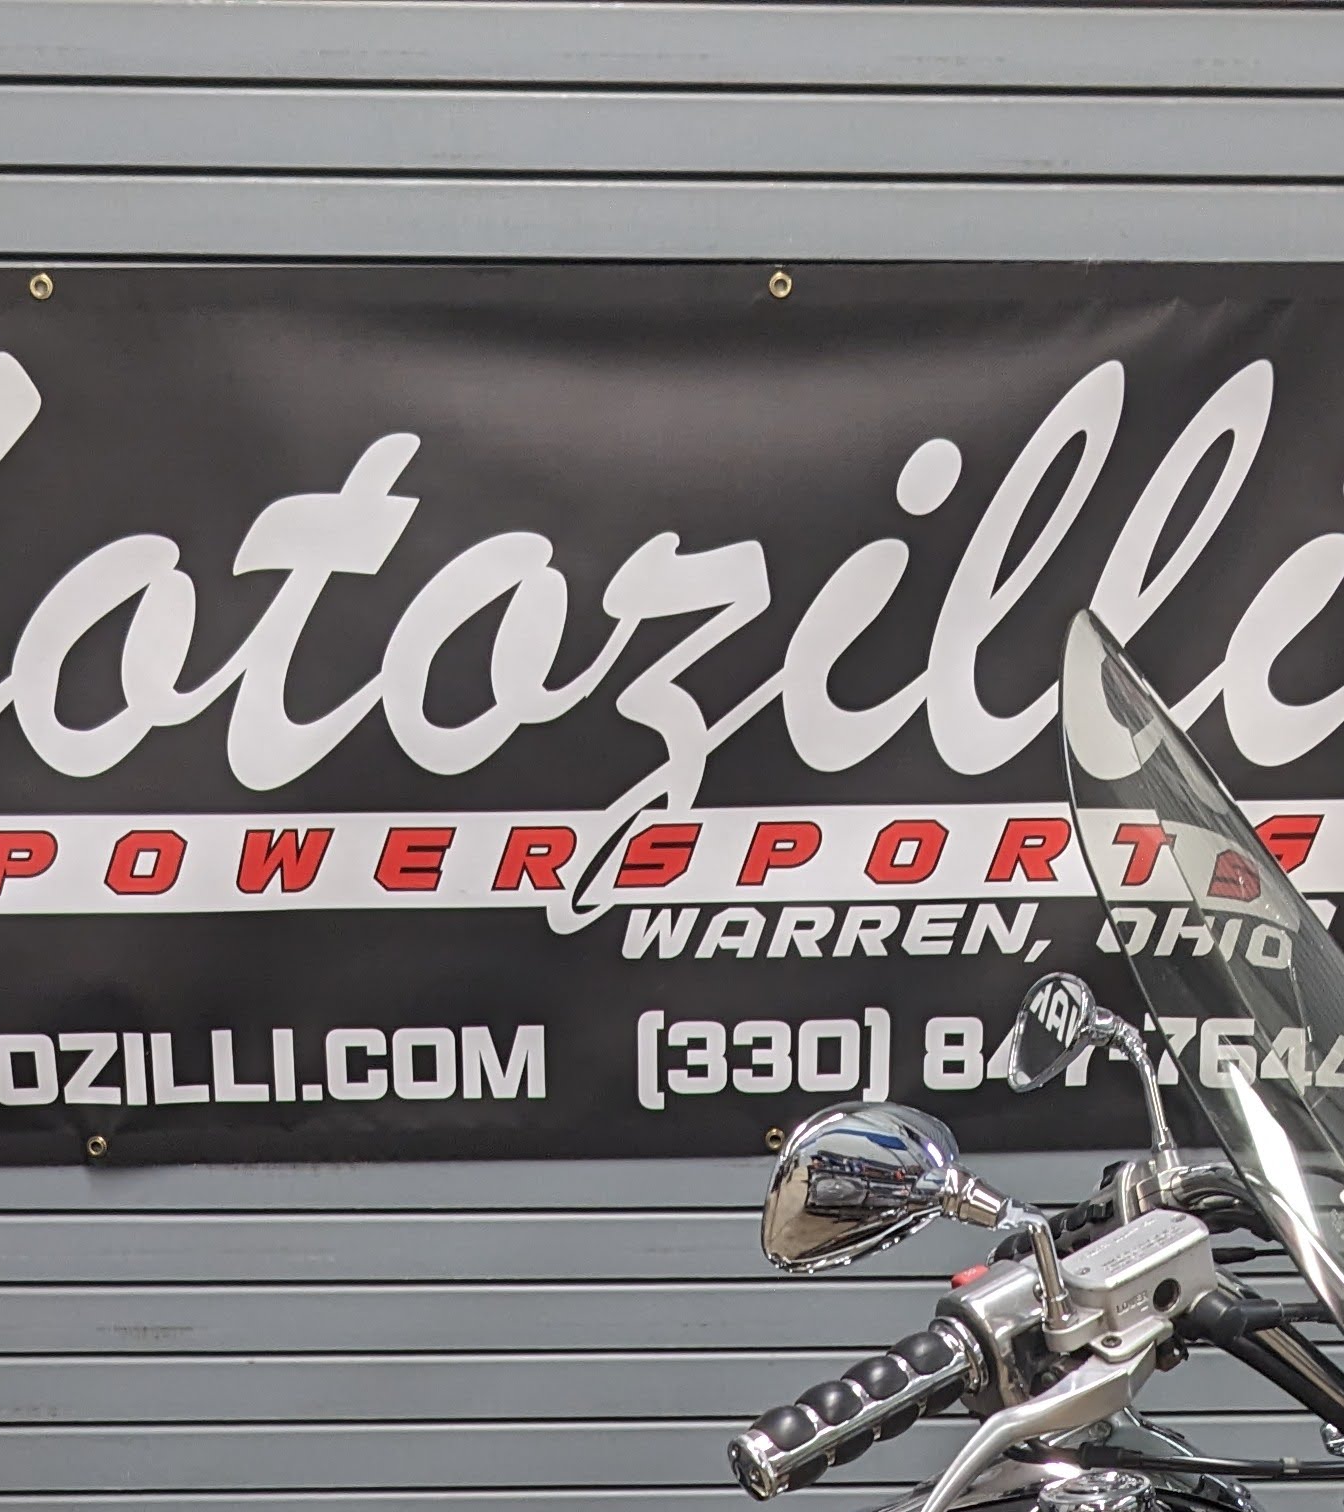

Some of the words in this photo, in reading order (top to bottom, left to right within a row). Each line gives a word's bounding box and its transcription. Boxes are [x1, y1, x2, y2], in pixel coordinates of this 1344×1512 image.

[621, 903, 1054, 963] WARREN,
[1096, 900, 1336, 970] OHIO
[636, 1008, 890, 1109] (330)
